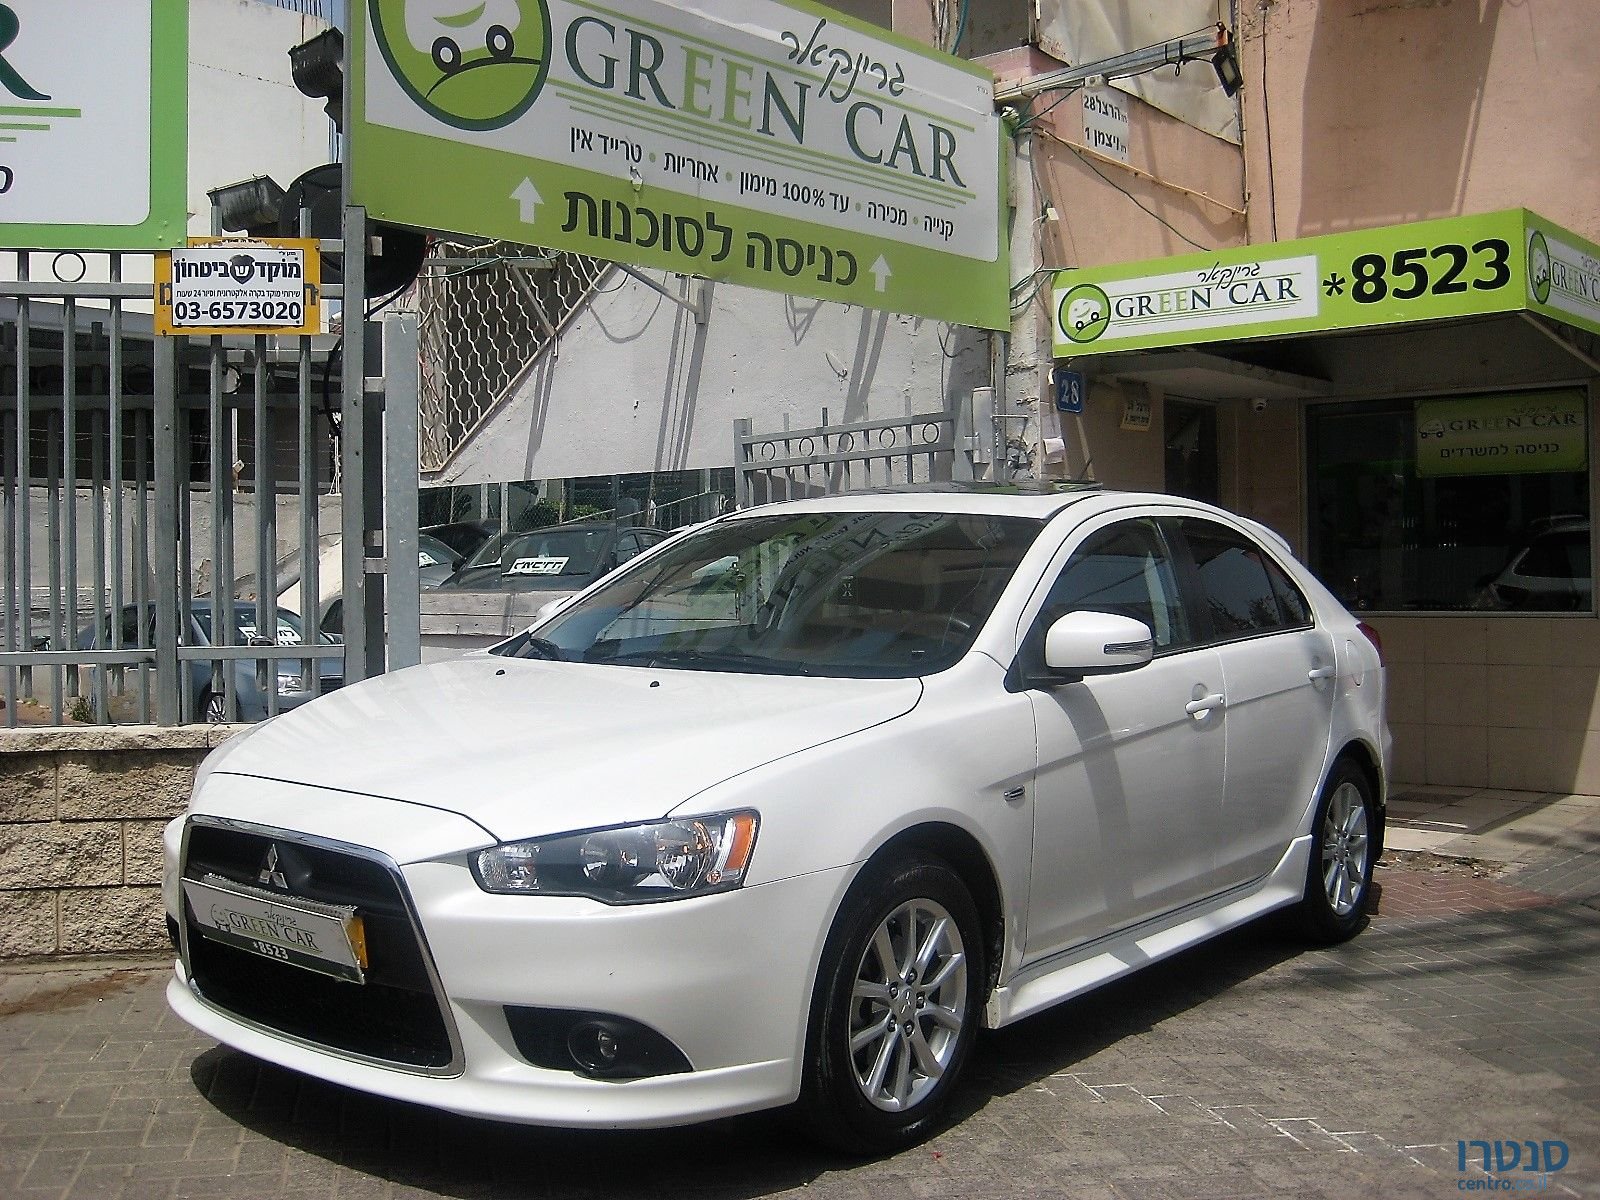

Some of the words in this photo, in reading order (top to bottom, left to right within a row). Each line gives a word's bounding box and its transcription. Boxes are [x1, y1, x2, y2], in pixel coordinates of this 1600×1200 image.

[780, 18, 906, 103] גרינקאר
[564, 16, 812, 145] GREEN
[845, 101, 967, 188] CAR
[570, 126, 593, 153] אין
[598, 133, 642, 163] טרייד
[1094, 129, 1119, 151] ויצמן
[663, 152, 719, 184] אחריות
[740, 171, 777, 197] מימון
[782, 182, 825, 208] 100%
[829, 192, 850, 213] עד
[867, 201, 907, 226] מכירה
[561, 191, 733, 262] לסוכנות
[924, 215, 954, 241] קנייה
[174, 259, 230, 284] ביטחון
[254, 259, 301, 283] מוקד
[746, 231, 858, 286] כניסה
[1197, 261, 1261, 290] גרינקאר
[193, 289, 201, 298] 24
[1115, 287, 1213, 318] GREEN
[1228, 277, 1300, 305] CAR
[174, 301, 301, 320] 03-6573020
[1061, 379, 1079, 405] 28
[1532, 412, 1577, 427] CAR
[1440, 443, 1508, 458] למשרדים
[1515, 442, 1560, 455] כניסה
[229, 912, 280, 938] GREEN
[284, 926, 319, 950] CAR
